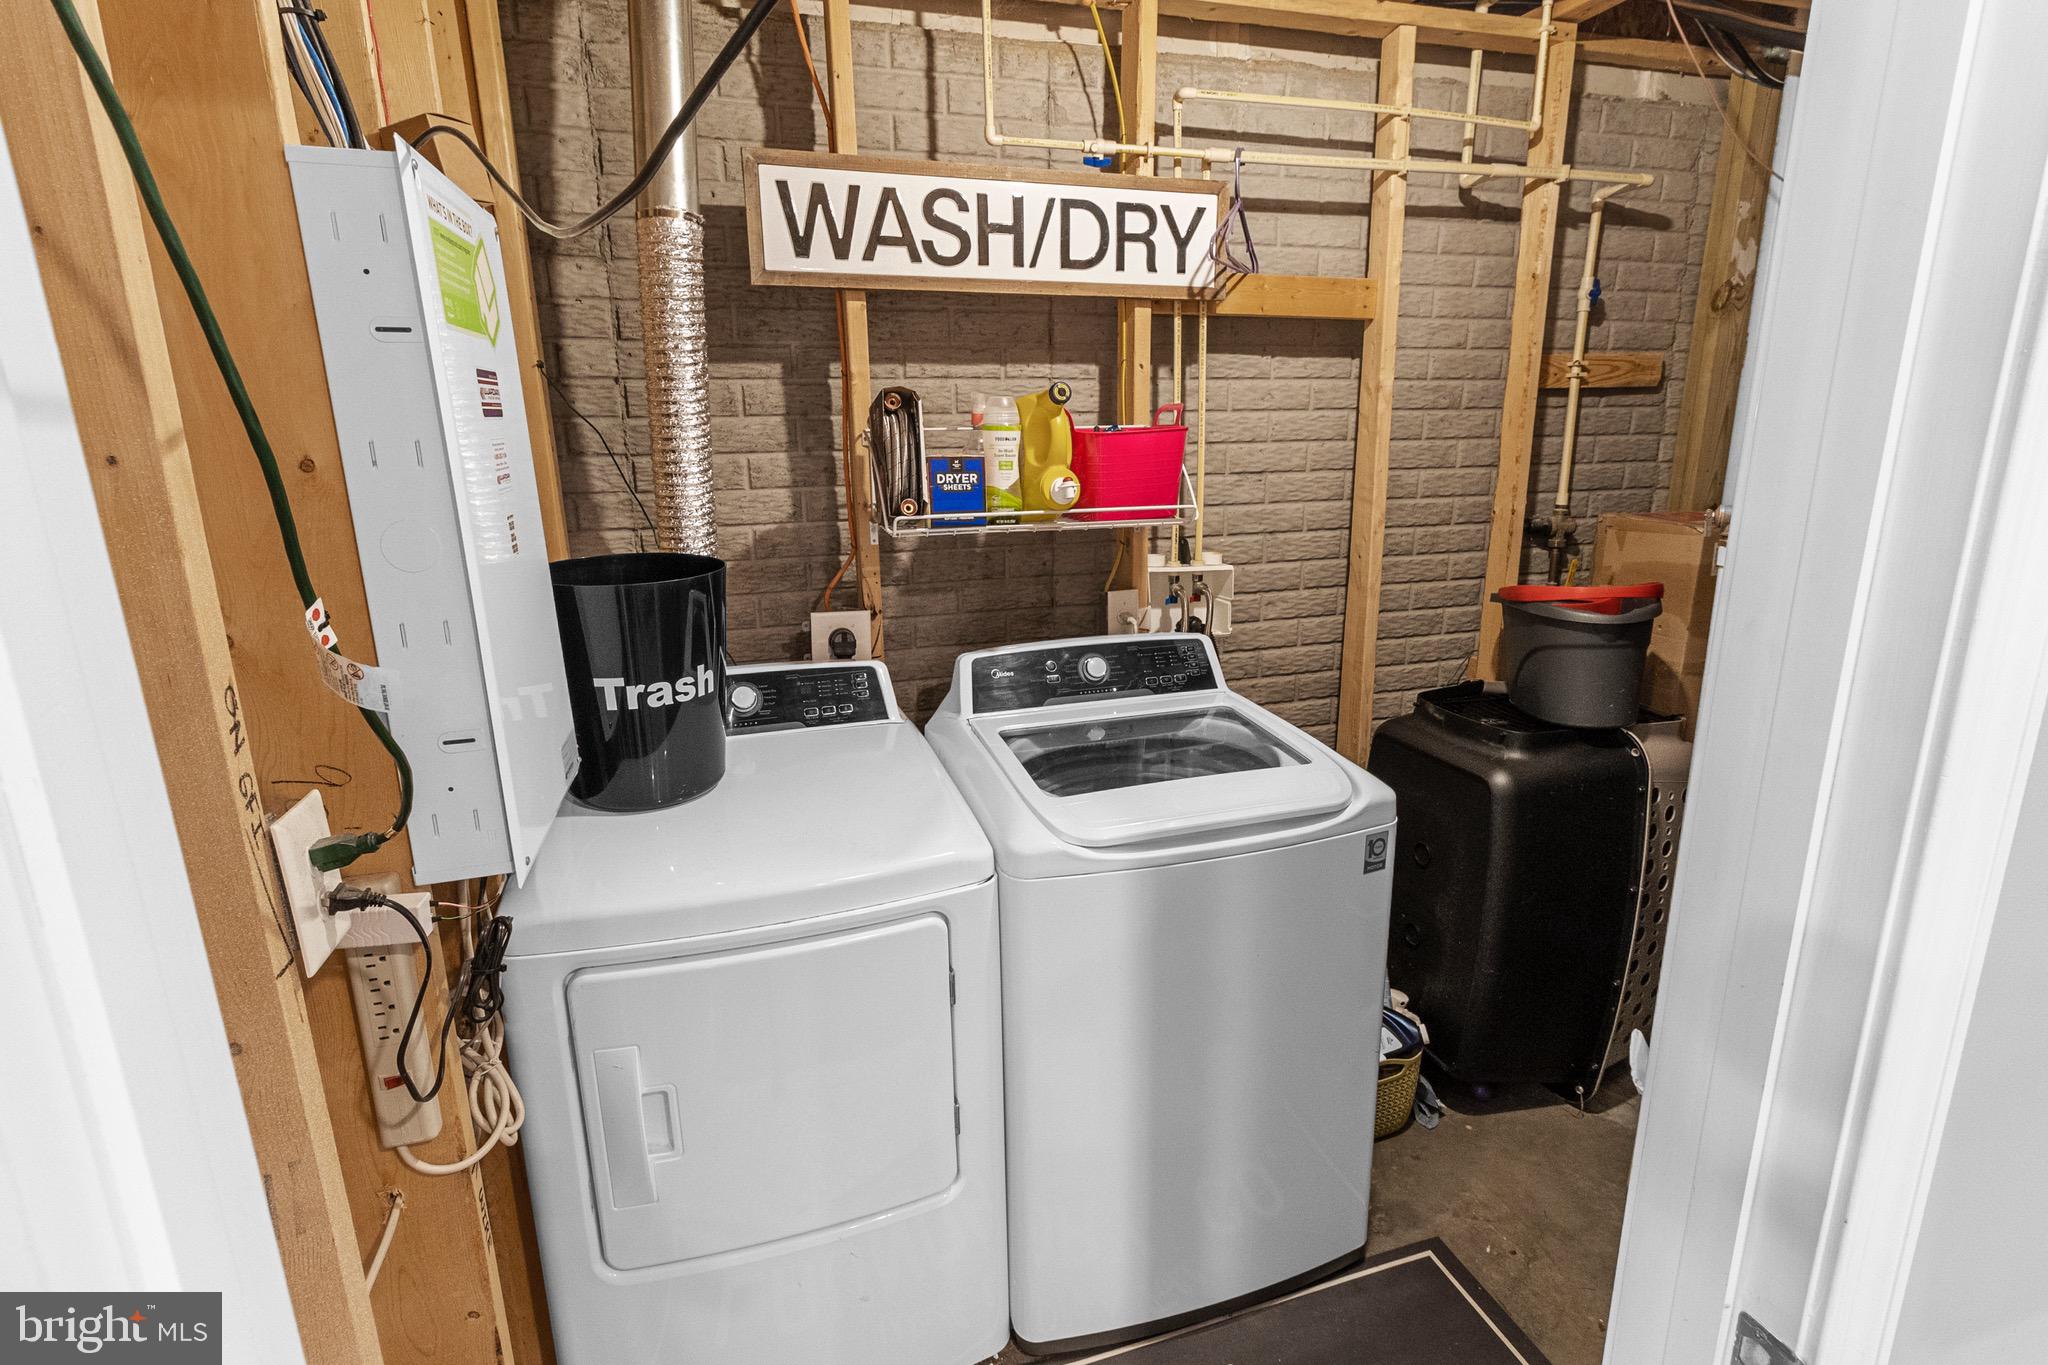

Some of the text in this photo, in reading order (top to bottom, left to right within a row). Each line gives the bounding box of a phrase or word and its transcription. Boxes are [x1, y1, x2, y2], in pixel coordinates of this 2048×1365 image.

[775, 180, 1207, 275] WASH/DRY
[936, 474, 978, 484] DRYER
[943, 483, 971, 491] SHEETS
[593, 664, 714, 710] Trash
